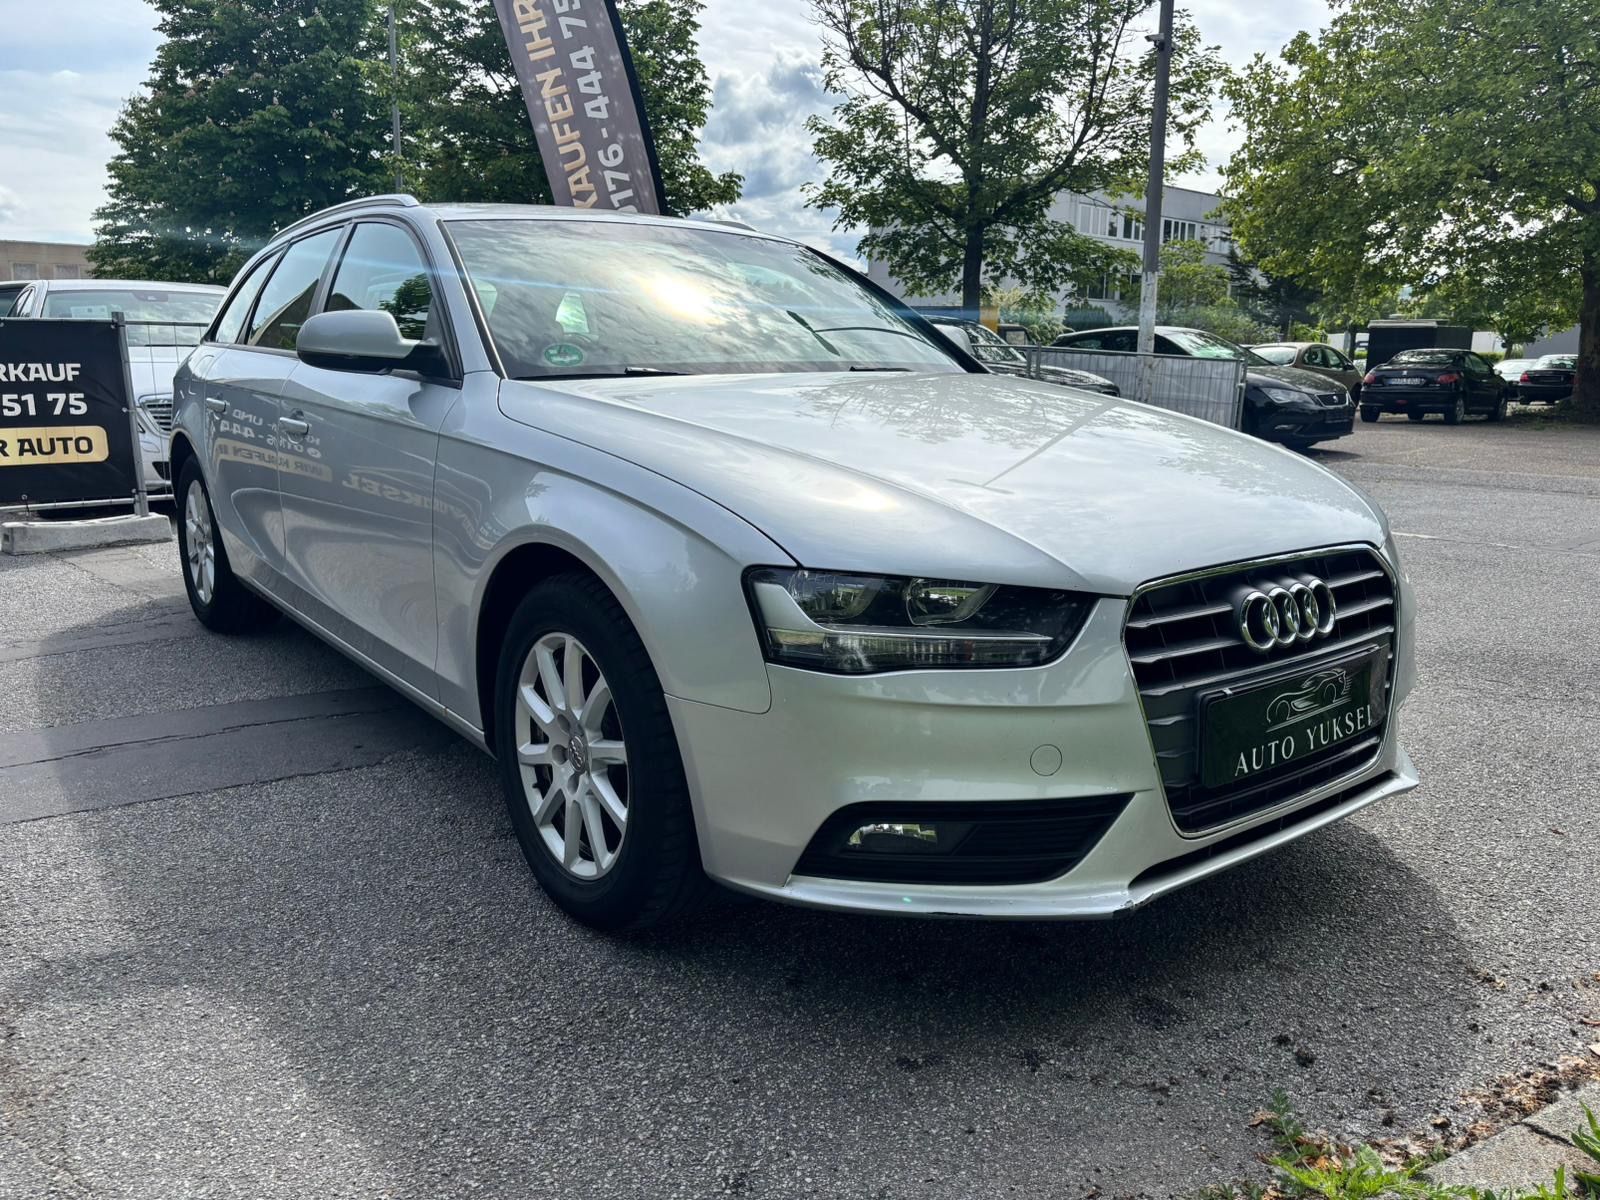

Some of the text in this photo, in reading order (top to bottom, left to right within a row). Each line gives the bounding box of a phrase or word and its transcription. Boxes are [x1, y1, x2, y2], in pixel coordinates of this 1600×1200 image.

[552, 0, 588, 40] 75
[569, 45, 610, 120] 444
[513, 0, 598, 209] KAUFEN IHR
[2, 393, 88, 417] 51 75
[17, 436, 93, 457] AUTO
[1234, 735, 1295, 777] AUTO
